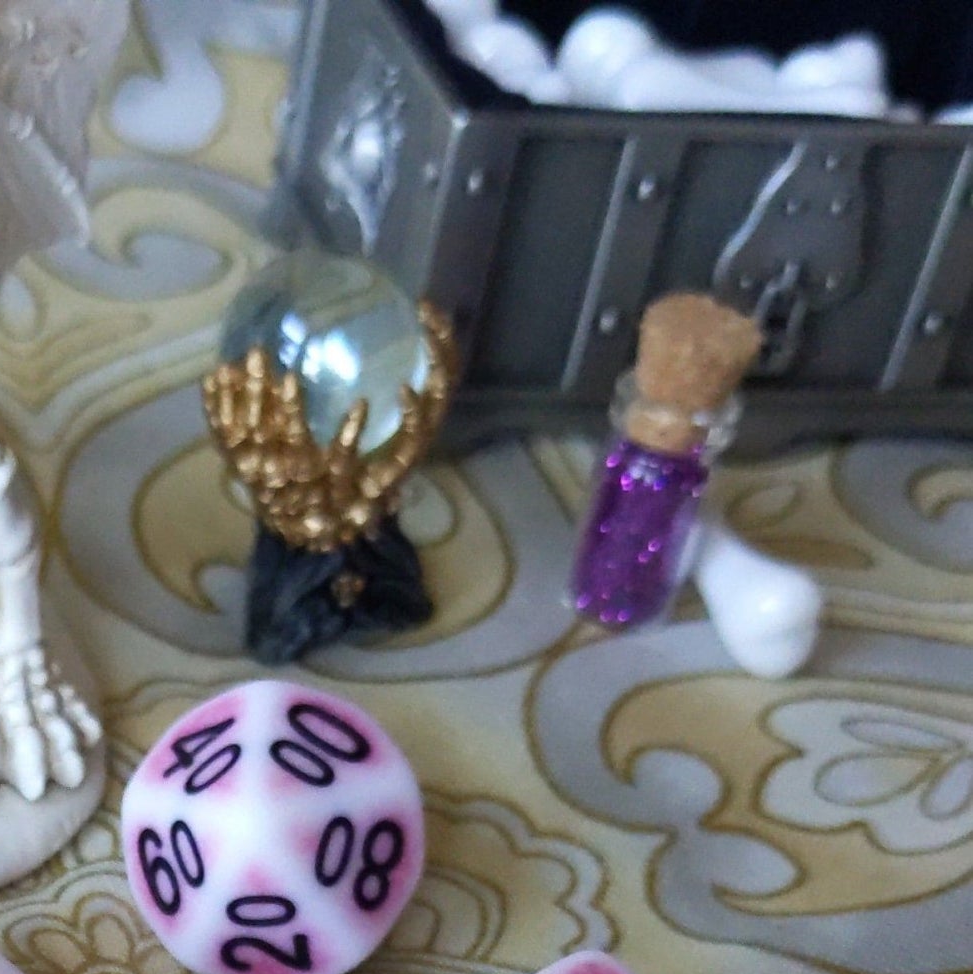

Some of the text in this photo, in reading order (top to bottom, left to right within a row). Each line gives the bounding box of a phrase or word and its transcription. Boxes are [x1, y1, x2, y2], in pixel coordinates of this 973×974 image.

[162, 717, 242, 795] 40
[268, 700, 375, 789] 00
[137, 819, 205, 917] 60
[315, 816, 405, 911] 80
[220, 895, 313, 973] 20
